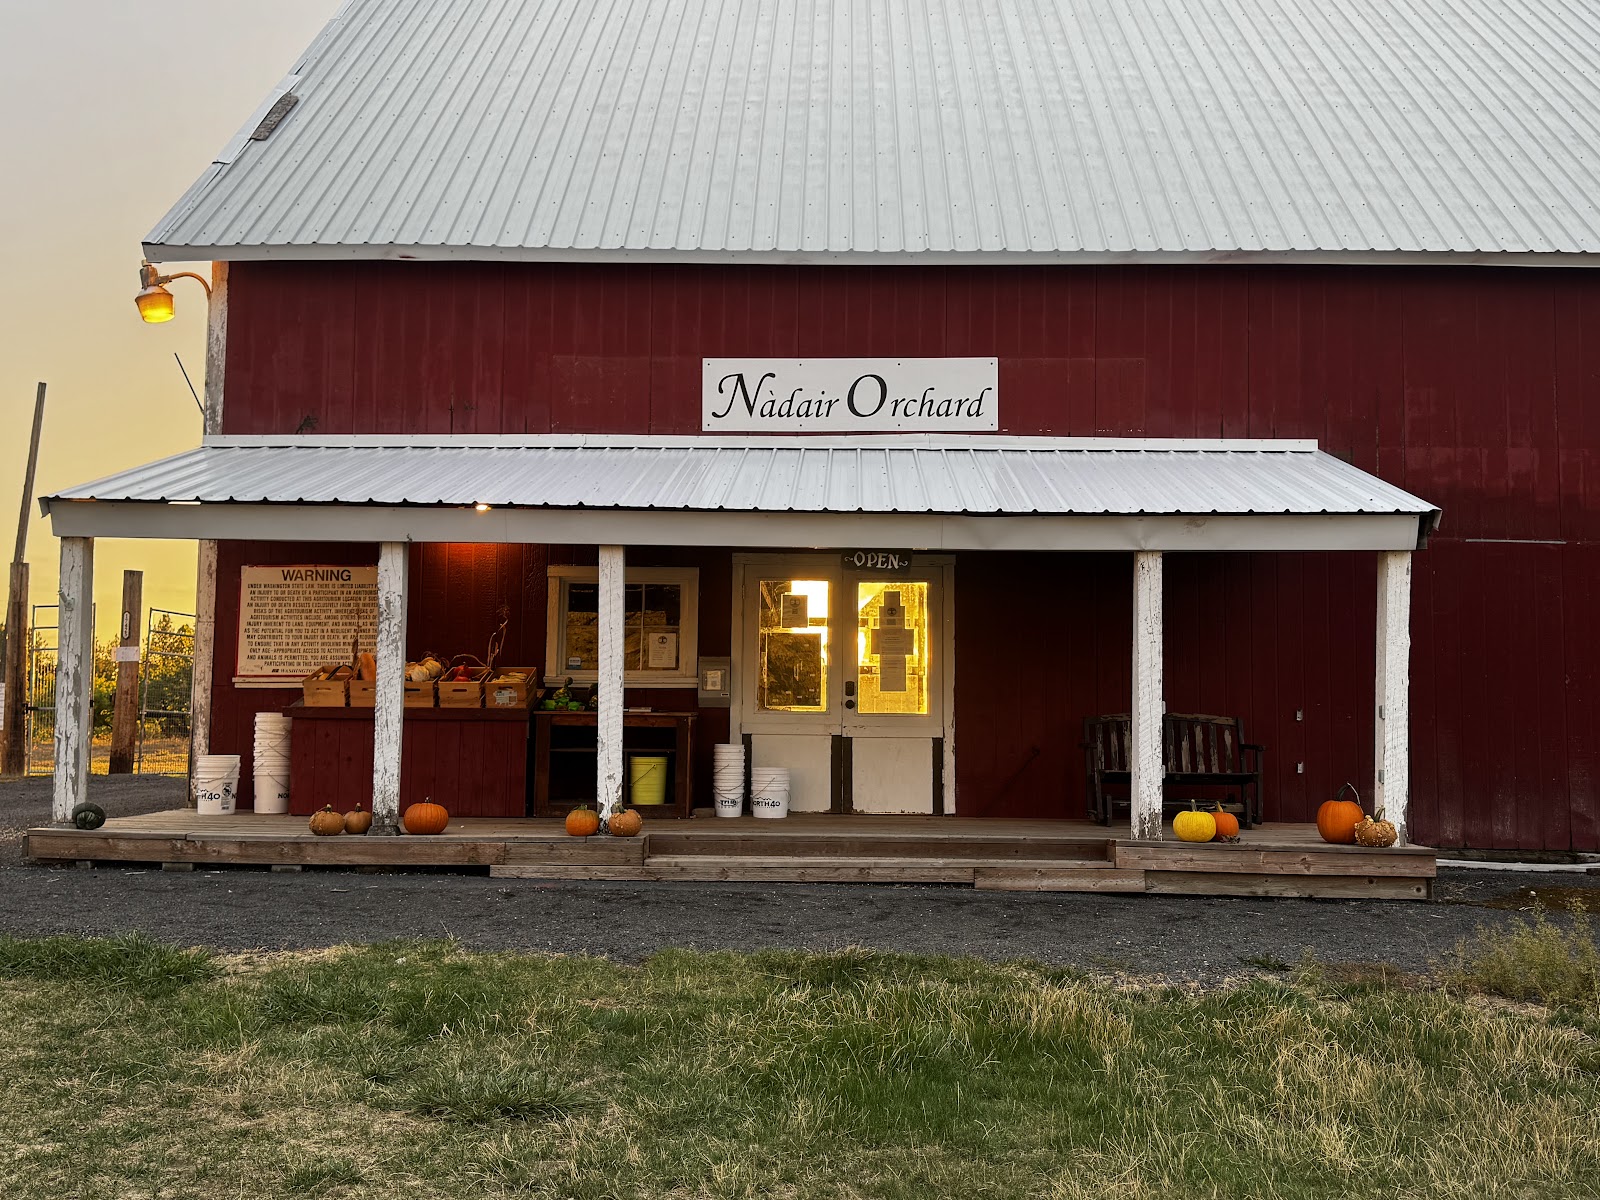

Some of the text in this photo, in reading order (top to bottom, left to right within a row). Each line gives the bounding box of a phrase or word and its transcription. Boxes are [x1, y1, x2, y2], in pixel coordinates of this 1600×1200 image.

[712, 372, 993, 418] Nàdair Orchard
[854, 551, 900, 570] OPEN
[282, 569, 351, 582] WARNING
